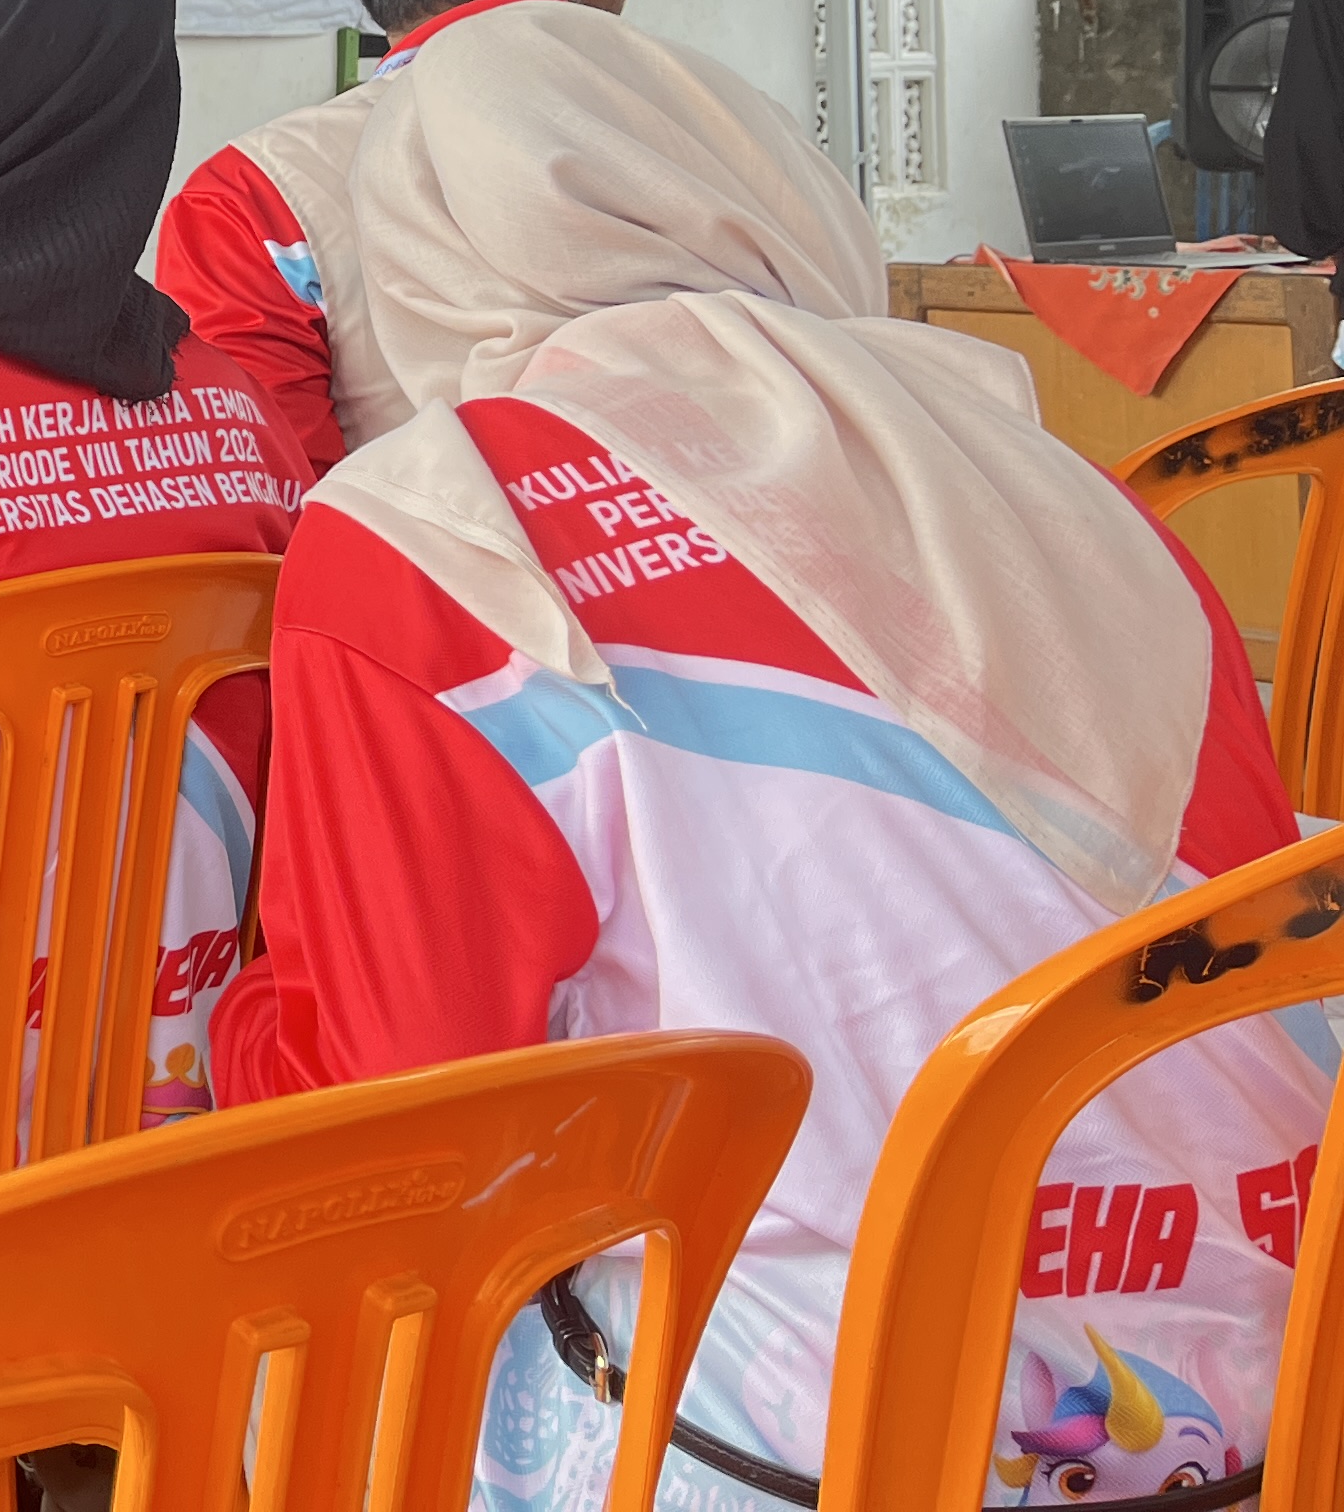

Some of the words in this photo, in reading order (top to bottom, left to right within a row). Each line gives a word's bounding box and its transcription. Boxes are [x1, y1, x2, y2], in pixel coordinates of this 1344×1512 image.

[19, 398, 109, 441] KERJA
[112, 390, 192, 431] NYATA
[77, 440, 123, 479] VIII
[124, 429, 213, 472] TAHUN
[506, 452, 643, 511] KULIA
[90, 473, 218, 520] DEHASEN
[555, 525, 728, 604] NIVERS
[152, 927, 238, 1017] ENA
[1020, 1182, 1199, 1298] EHA
